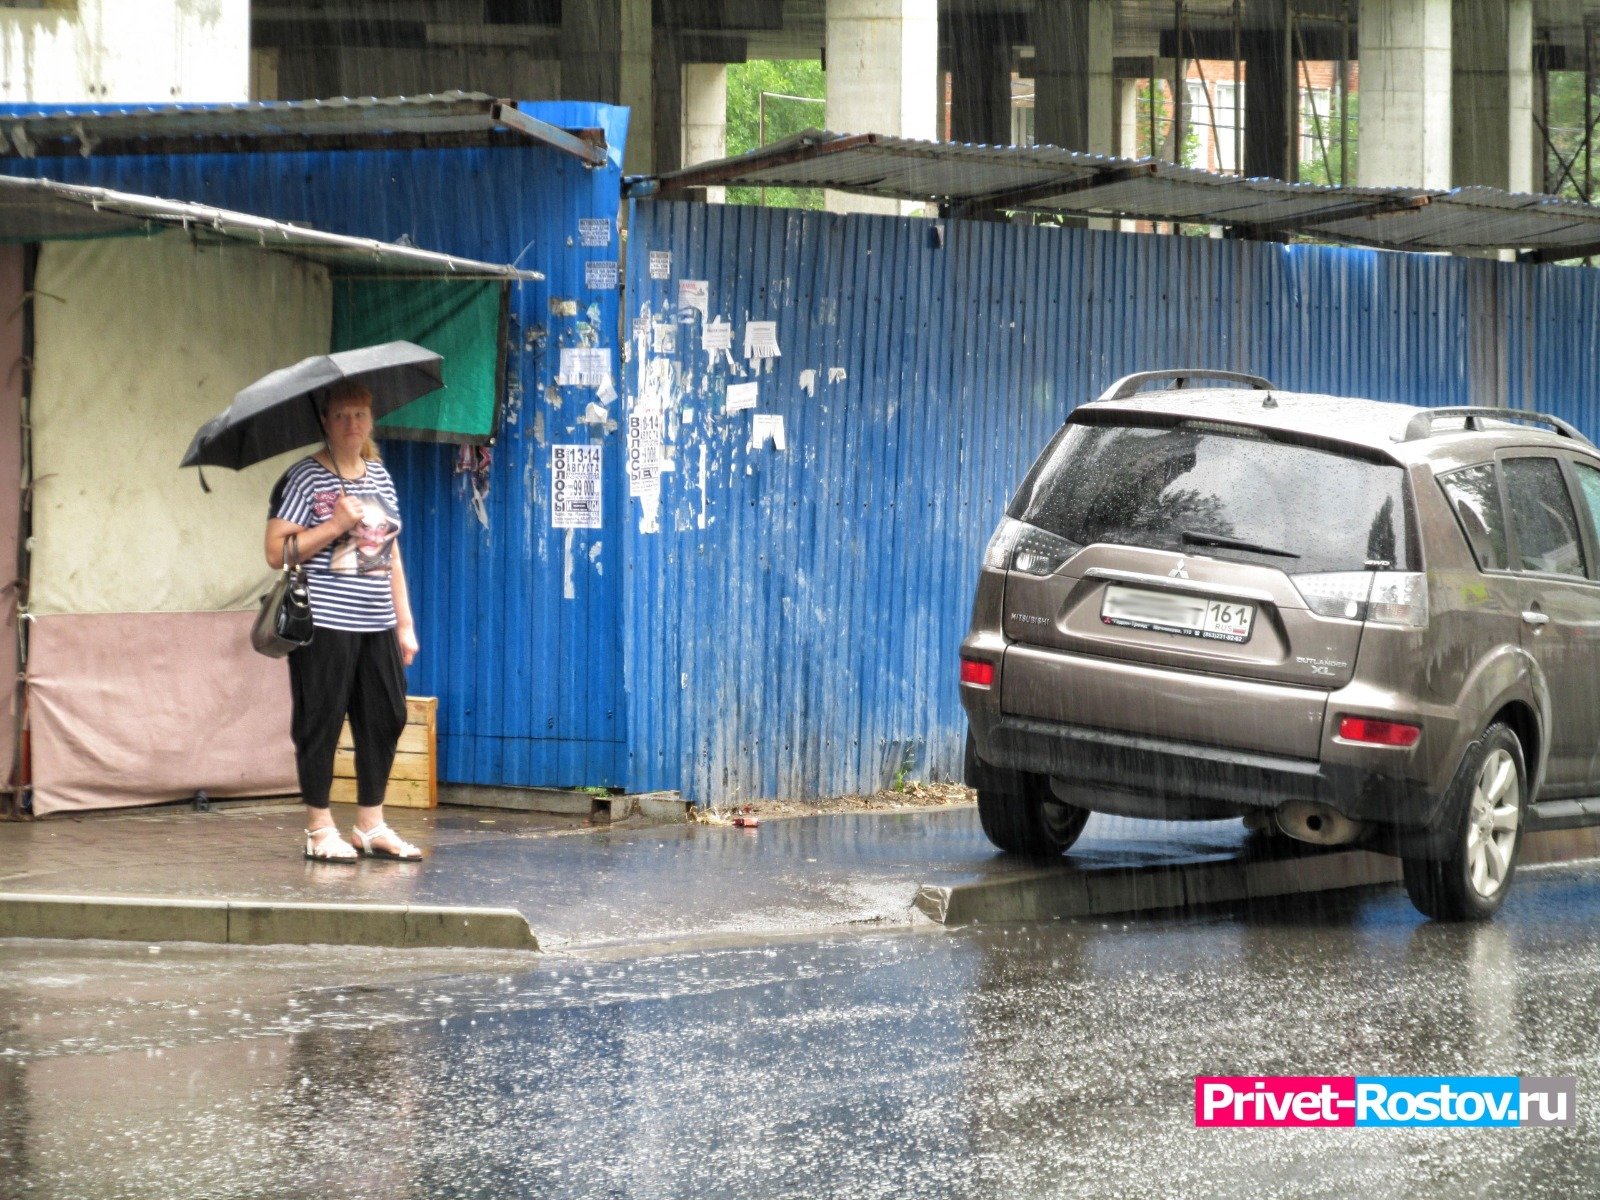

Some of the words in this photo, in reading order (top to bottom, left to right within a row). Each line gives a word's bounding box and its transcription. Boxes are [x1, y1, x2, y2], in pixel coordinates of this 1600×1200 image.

[569, 448, 600, 463] 13-14
[631, 416, 641, 481] ВОЛОСЫ
[566, 463, 600, 473] АВГУСТА
[554, 448, 566, 512] ВОЛОСЫ
[1010, 612, 1050, 626] MITSUBISHI
[1211, 603, 1244, 626] 161
[1214, 623, 1233, 633] RUS
[1296, 656, 1348, 668] OUTLANDER
[1311, 665, 1336, 676] XL
